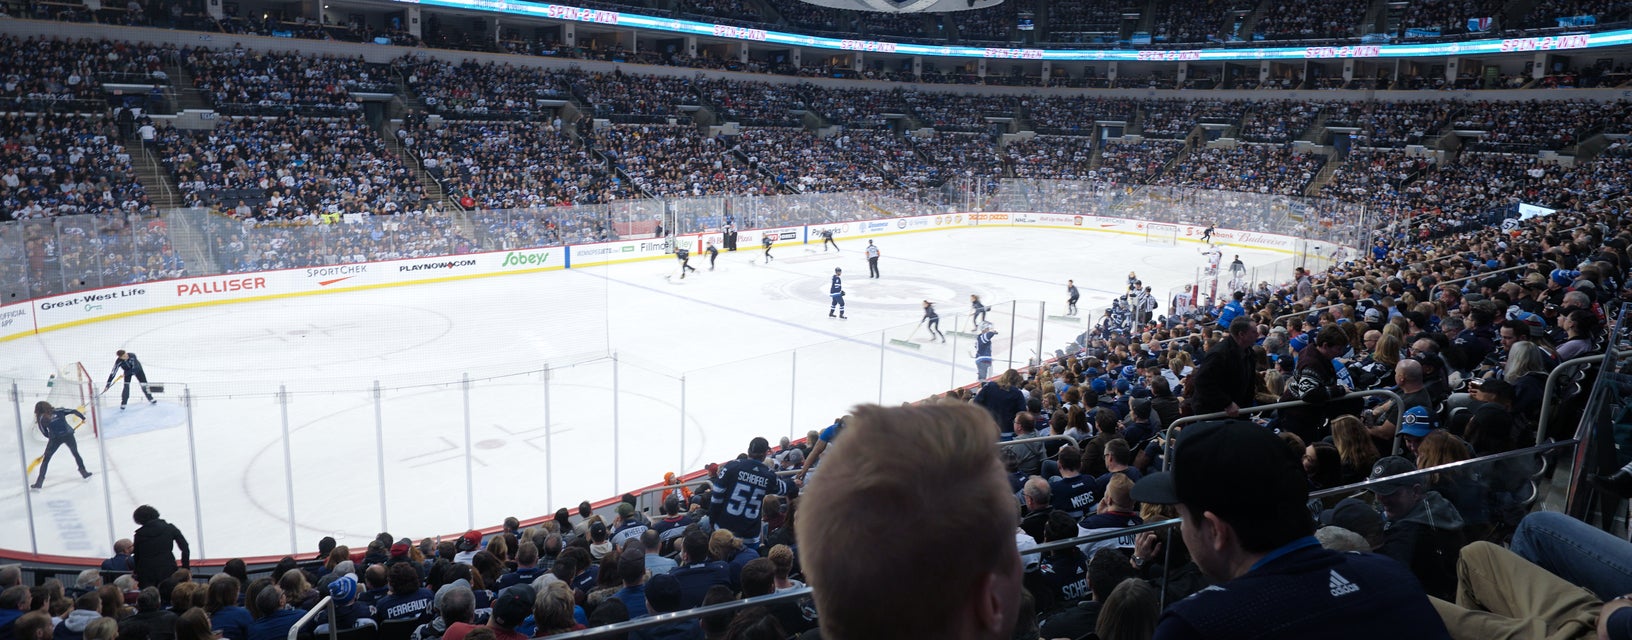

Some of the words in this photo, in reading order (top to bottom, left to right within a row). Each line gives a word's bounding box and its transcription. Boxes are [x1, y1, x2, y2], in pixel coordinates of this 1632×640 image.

[549, 5, 618, 23] SPIN-2-WIN
[713, 24, 767, 42] SPIN-2-WIN
[840, 39, 896, 53] SPIN-2-WIN
[1306, 46, 1380, 57] SPIN-2-WIN
[1502, 38, 1588, 52] SPIN-2-WIN
[983, 48, 1044, 60] SPIN-2-WIN
[1137, 50, 1200, 61] SPIN-2-WIN
[1502, 221, 1517, 231] 57
[502, 252, 549, 268] Sobeys
[177, 277, 266, 297] PALLISER
[41, 291, 118, 311] Great-West
[121, 288, 146, 298] Life
[738, 470, 769, 488] SCHEIFELE
[727, 482, 766, 519] 55
[1070, 490, 1095, 508] MYERS
[1330, 583, 1361, 597] adidas
[387, 598, 429, 619] PERREAULT
